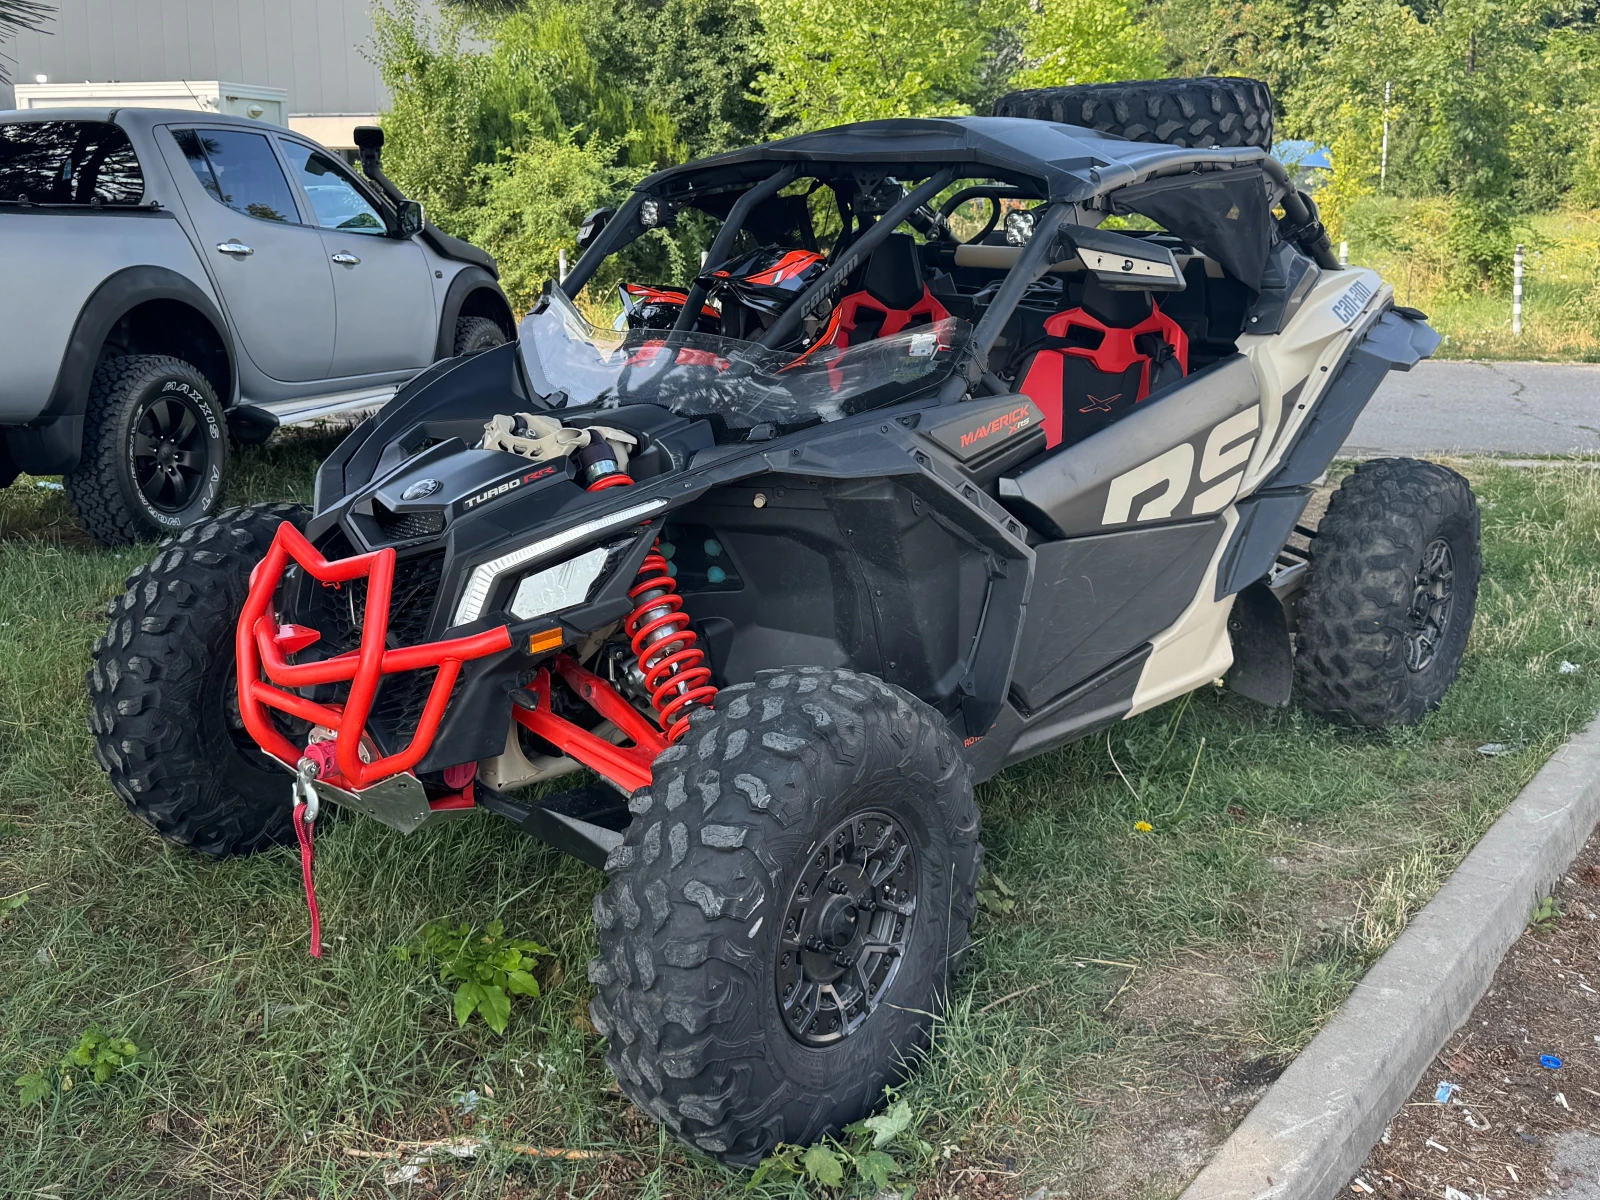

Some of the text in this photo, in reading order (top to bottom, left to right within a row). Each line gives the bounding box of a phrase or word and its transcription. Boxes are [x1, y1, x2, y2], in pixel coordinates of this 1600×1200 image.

[801, 254, 858, 319] can-am
[1331, 280, 1372, 325] can-am
[162, 381, 220, 439] MAXXIS
[960, 404, 1030, 448] MAVERICK
[202, 464, 220, 511] A/T
[464, 466, 555, 508] TURBO RR
[1102, 403, 1260, 525] RS
